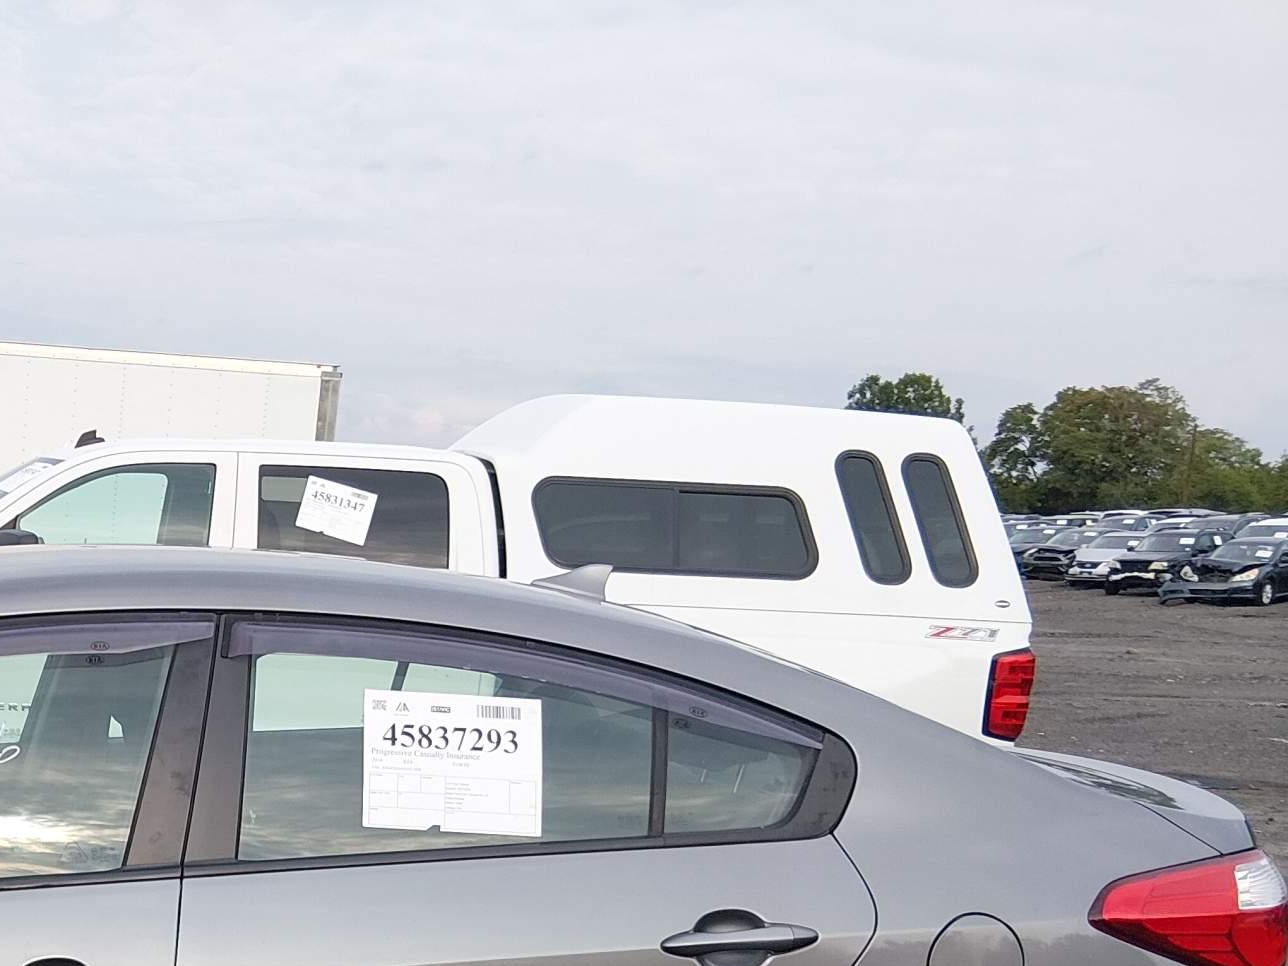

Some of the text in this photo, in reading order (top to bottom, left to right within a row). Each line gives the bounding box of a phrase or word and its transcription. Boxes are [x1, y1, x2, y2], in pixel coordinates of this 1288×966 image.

[312, 490, 365, 513] 45831347
[924, 624, 1000, 642] Z71
[383, 723, 518, 754] 45837293
